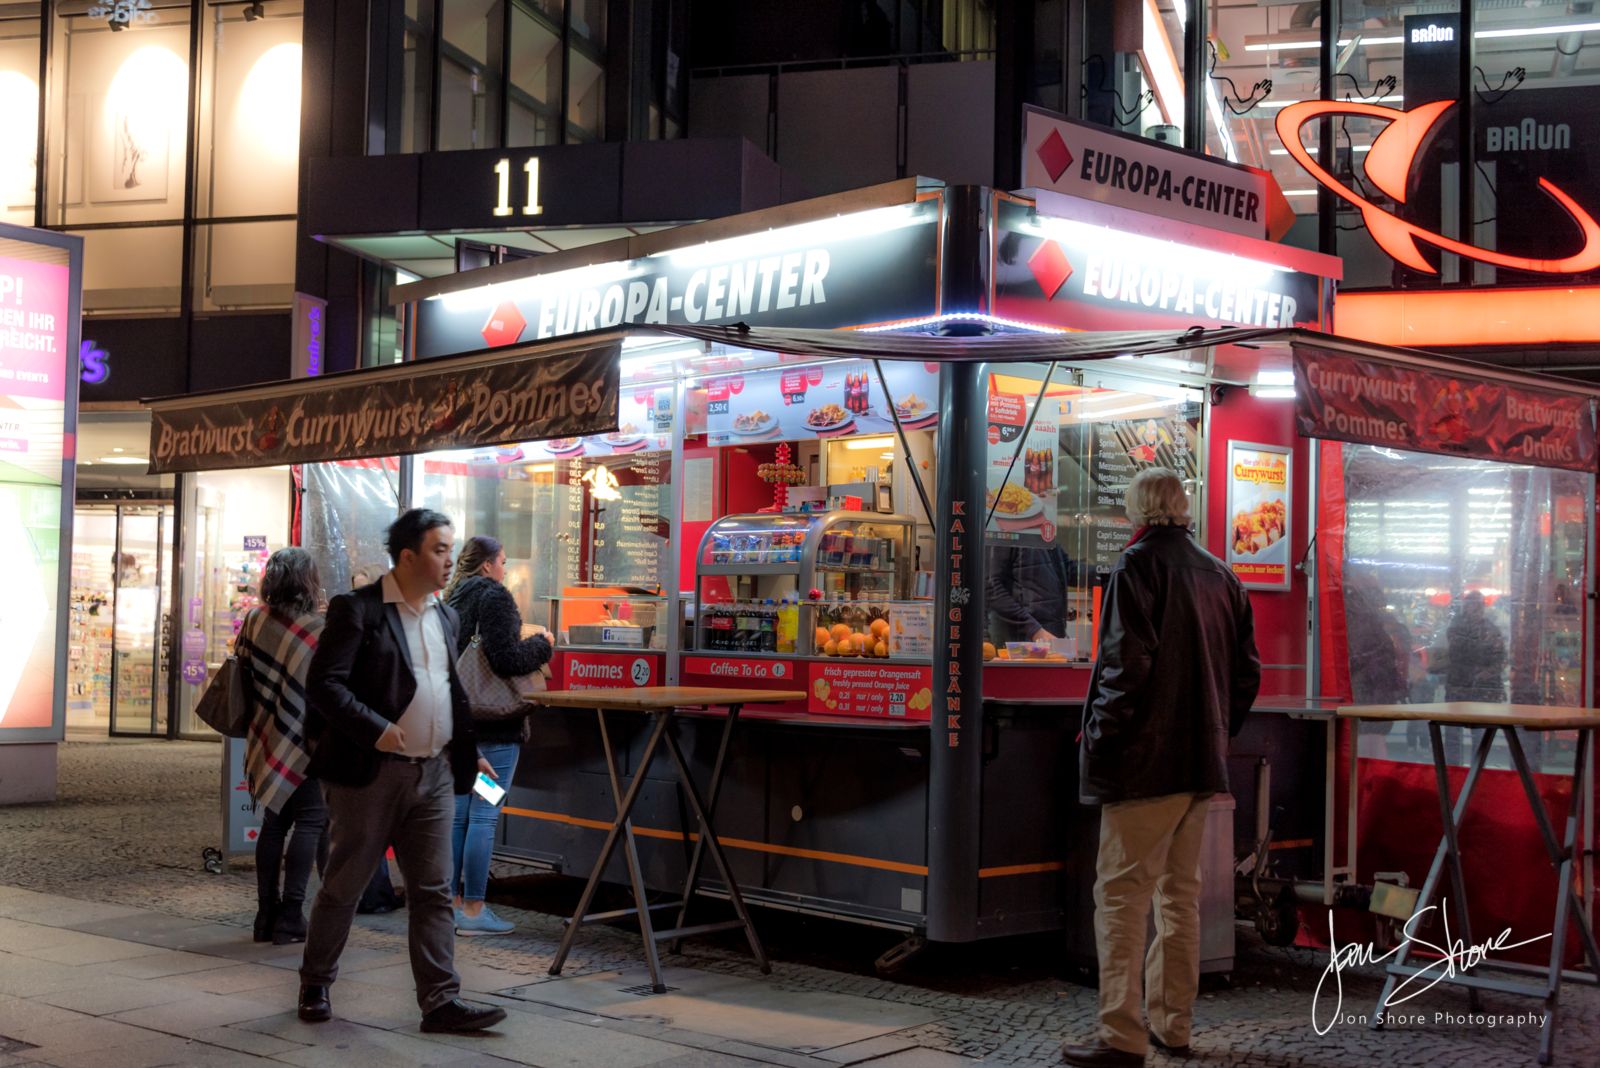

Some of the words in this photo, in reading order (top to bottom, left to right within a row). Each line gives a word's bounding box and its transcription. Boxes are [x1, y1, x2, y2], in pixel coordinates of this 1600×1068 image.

[1411, 24, 1453, 43] BRAUN
[1487, 118, 1571, 152] BRAUN
[492, 156, 543, 216] 11
[1080, 148, 1259, 222] EUROPA-CENTER
[537, 249, 831, 339] EUROPA-CENTER
[1083, 255, 1298, 328] EUROPA-CENTER
[29, 312, 55, 332] IHR
[1307, 362, 1416, 405] Currywurst
[1507, 396, 1583, 430] Bratwurst
[157, 416, 254, 458] Bratwurst
[470, 378, 605, 427] Pommes
[1324, 406, 1408, 440] Pommes
[1523, 435, 1573, 461] Drinks
[1234, 464, 1283, 482] Currywurst
[949, 500, 966, 587] KALTE
[569, 659, 623, 679] Pommes
[710, 662, 738, 675] Coffee
[741, 664, 752, 676] To
[754, 664, 767, 677] Go
[824, 666, 842, 676] frisch
[843, 668, 877, 679] gepresster
[879, 669, 921, 680] Orangensaft
[874, 682, 894, 690] Orange
[947, 607, 962, 747] GETRÄNKE
[871, 693, 884, 702] only
[871, 705, 884, 713] only
